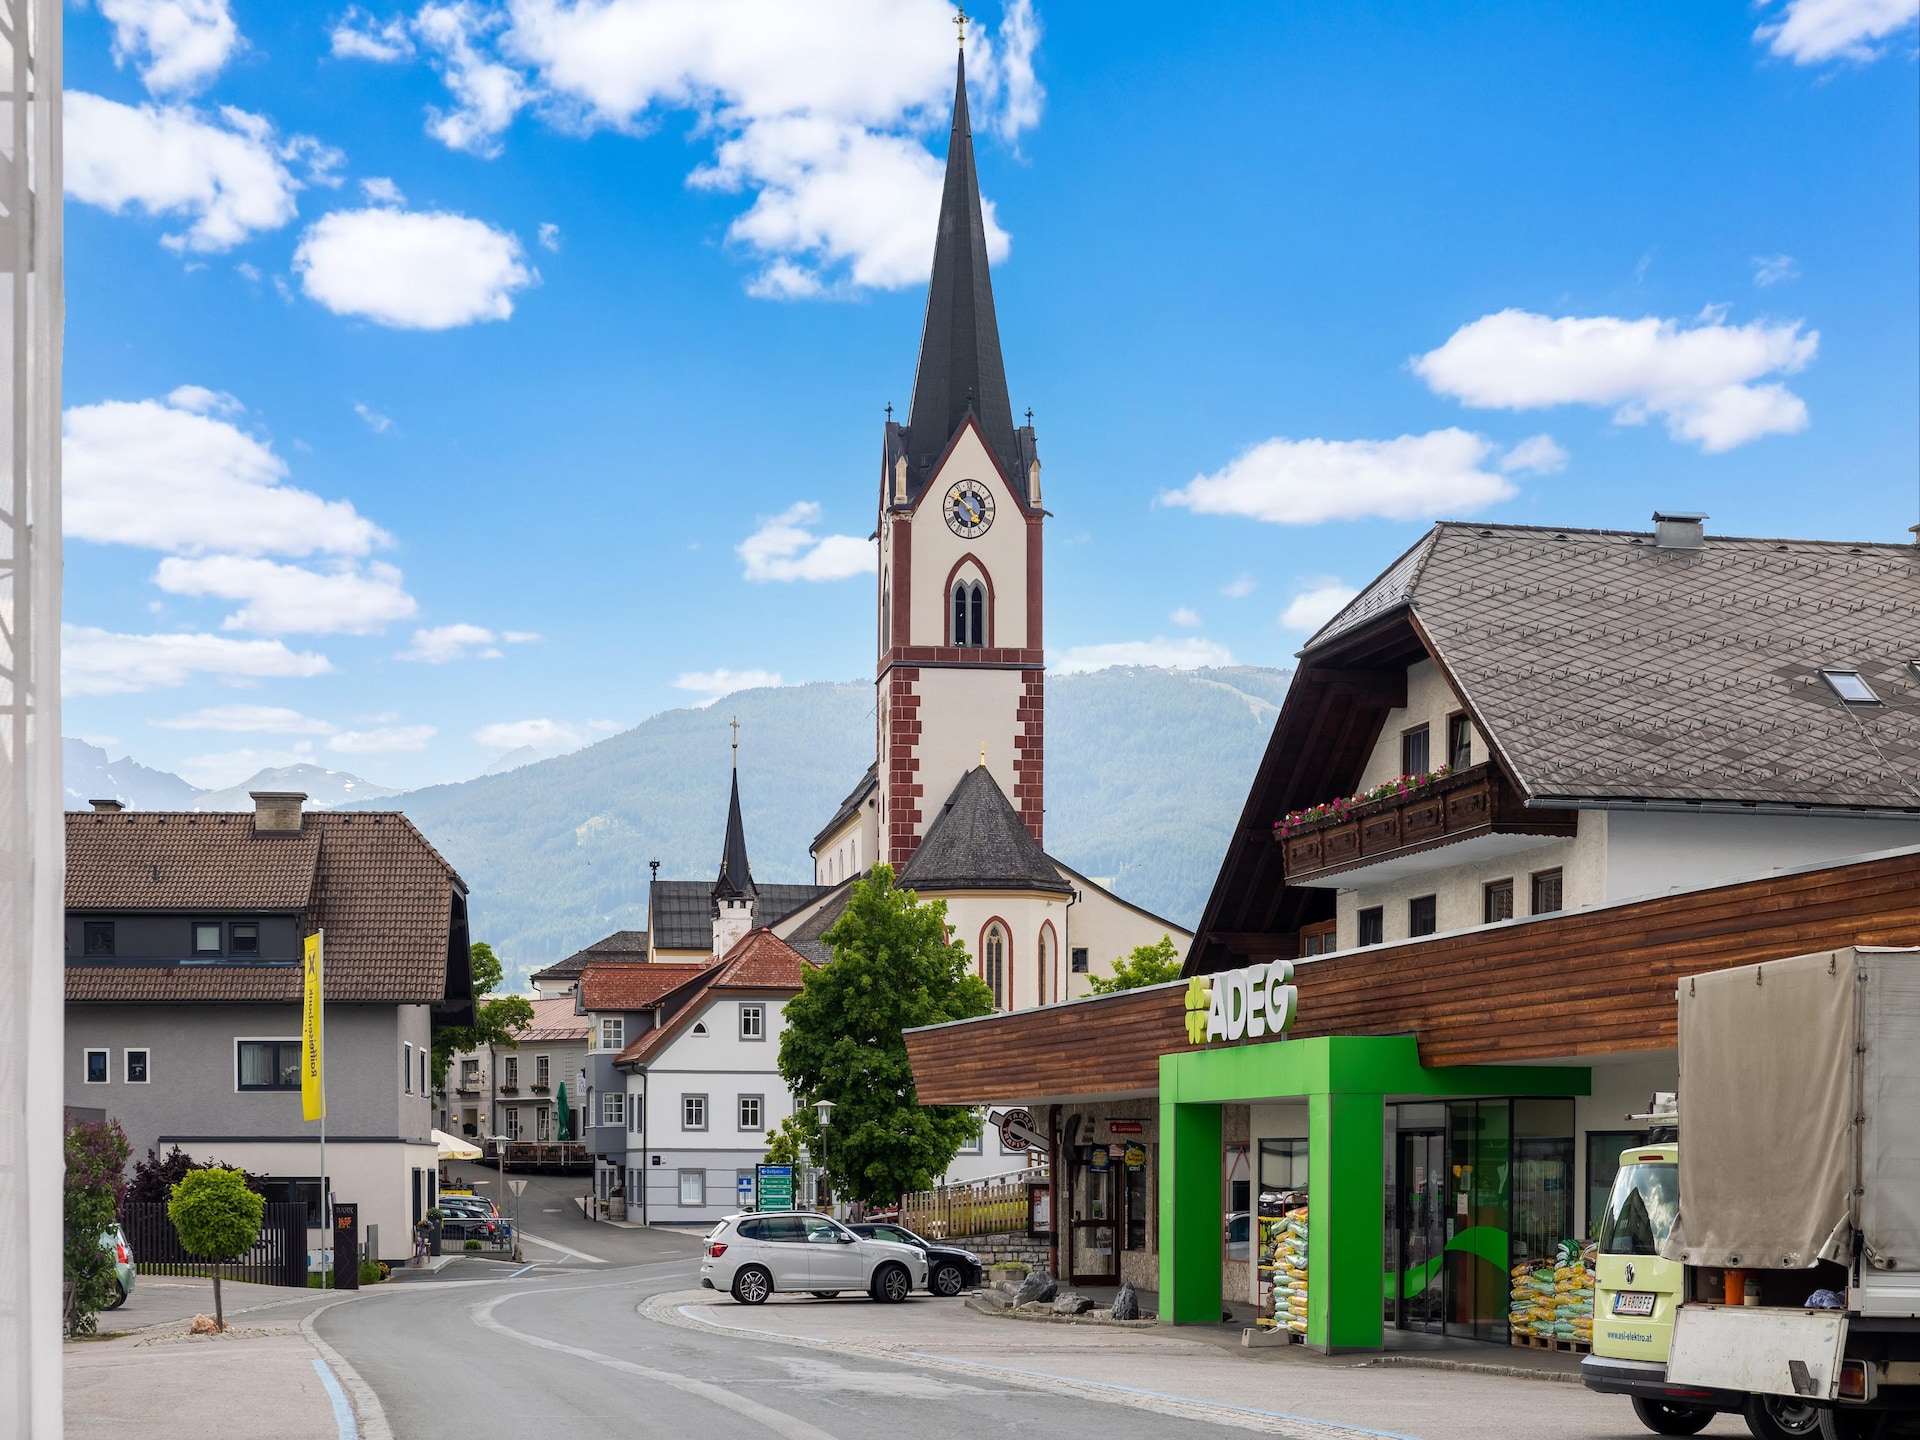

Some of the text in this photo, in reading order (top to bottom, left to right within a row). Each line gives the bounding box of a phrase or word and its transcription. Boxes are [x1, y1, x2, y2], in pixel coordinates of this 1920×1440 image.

[1207, 960, 1293, 1042] ADEG
[1007, 1112, 1033, 1128] TABAK
[1003, 1127, 1026, 1148] TRAFIK
